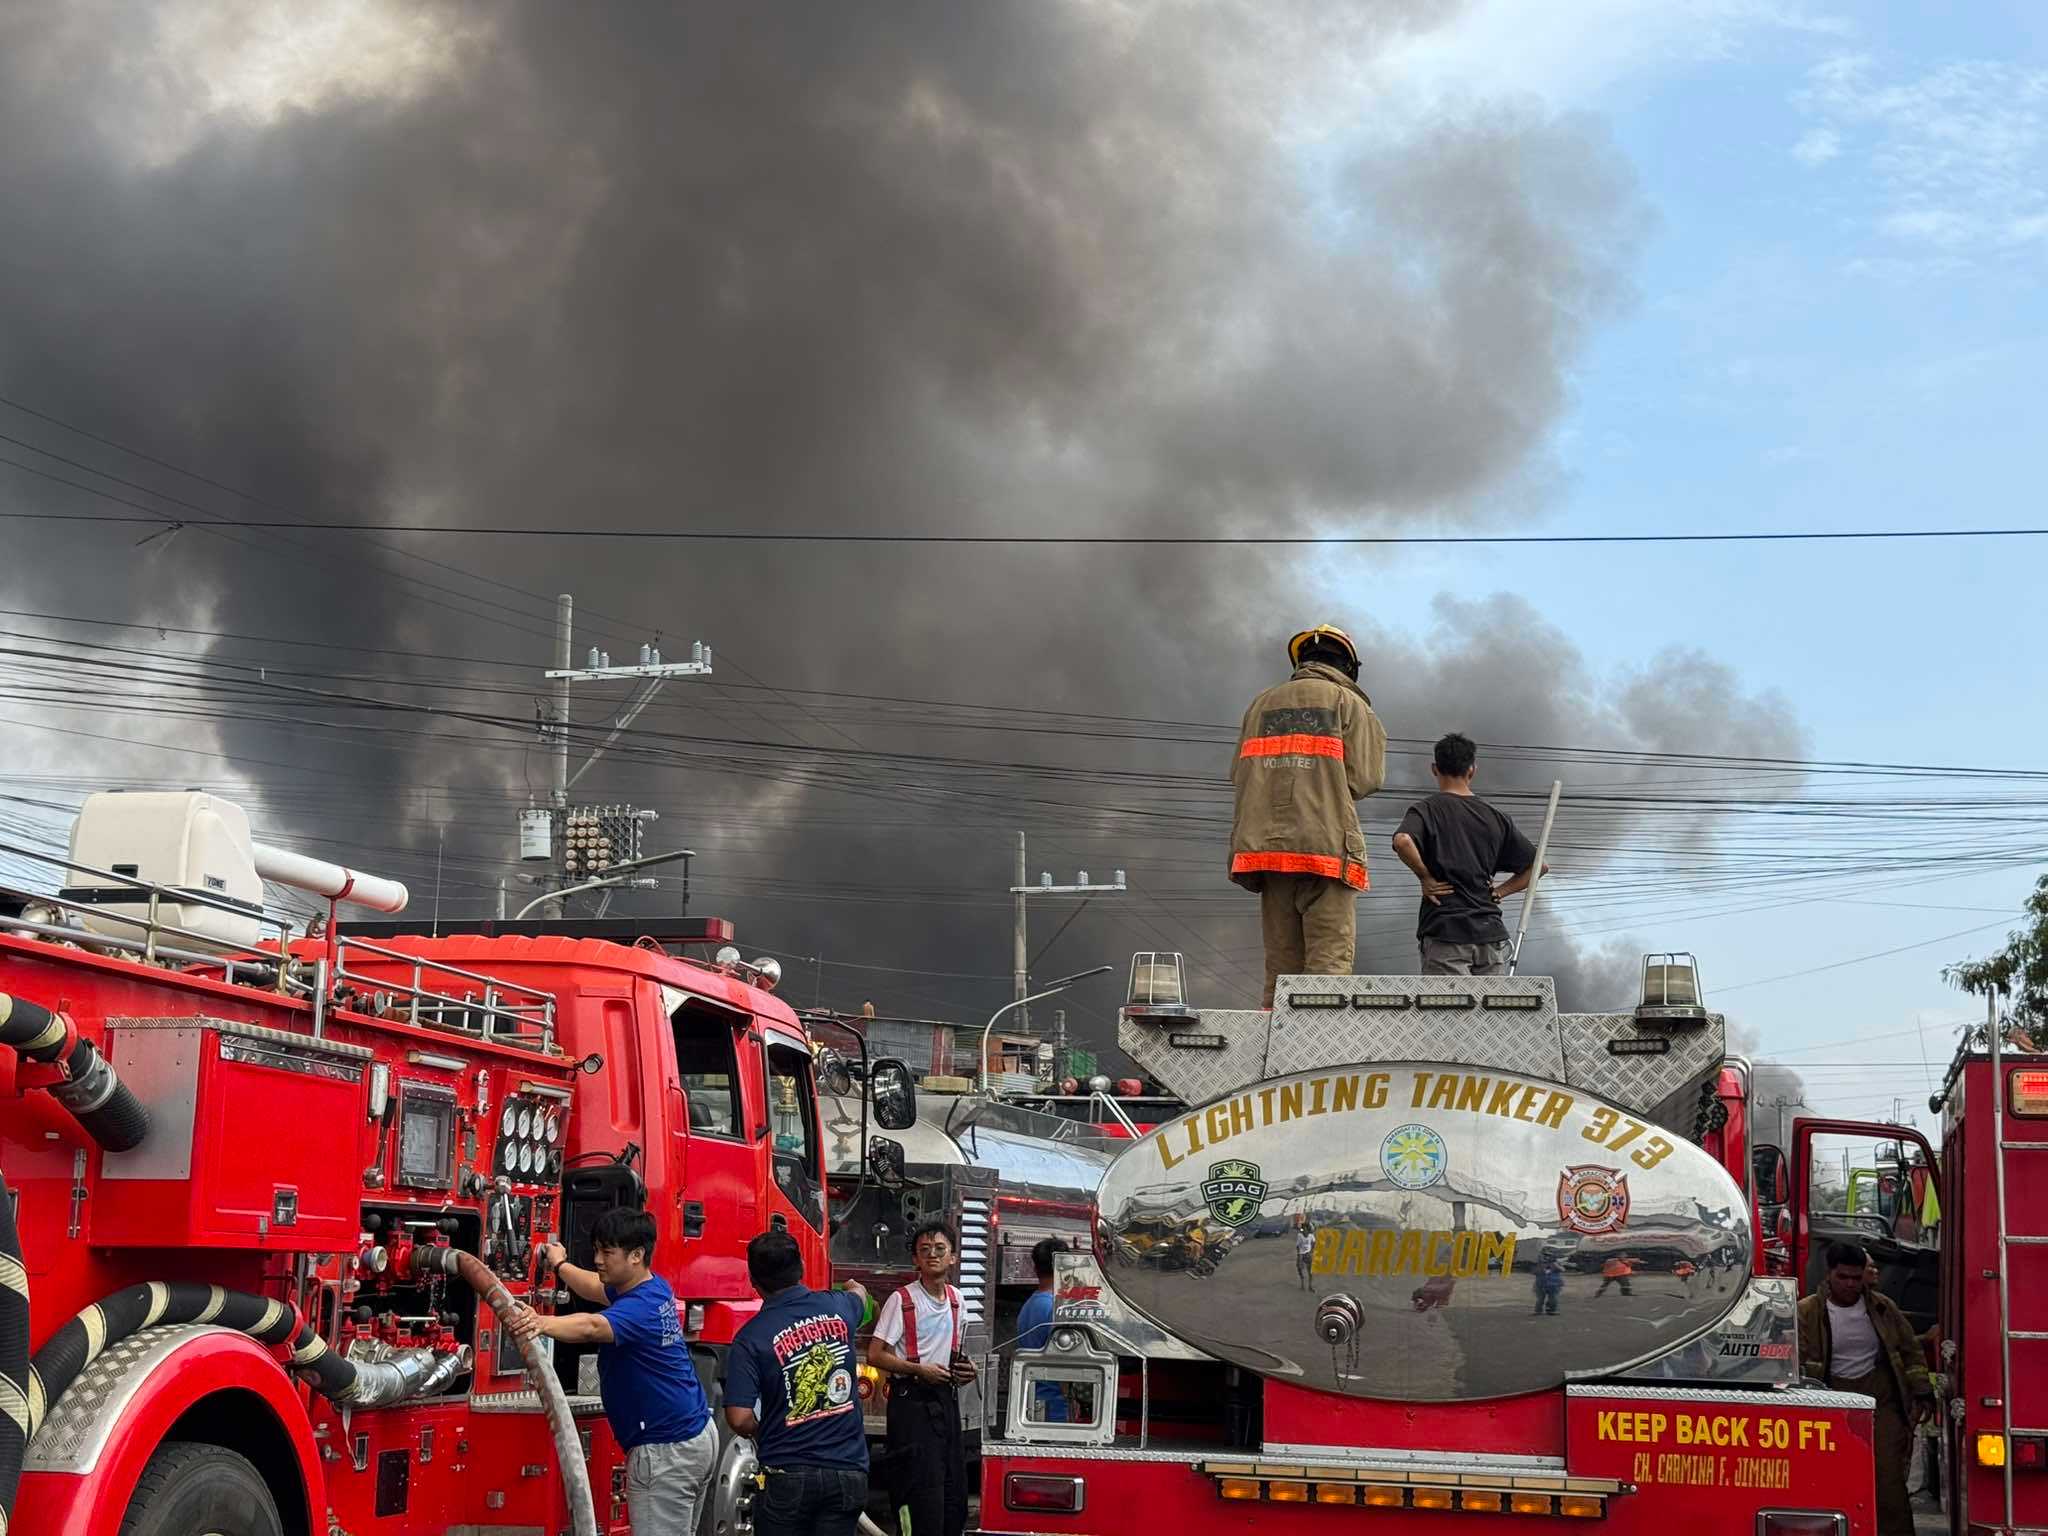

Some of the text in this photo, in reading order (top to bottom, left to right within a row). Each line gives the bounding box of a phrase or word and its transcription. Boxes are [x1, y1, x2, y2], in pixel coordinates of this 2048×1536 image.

[1155, 1072, 1674, 1170] LIGHTNING TANKER 373
[1312, 1228, 1517, 1279] BARACOM
[773, 1313, 843, 1344] 4TH MANILA
[1598, 1411, 1836, 1451] KEEP BACK 50 FT.
[1657, 1453, 1714, 1486] CARMINA
[1718, 1456, 1730, 1487] F.
